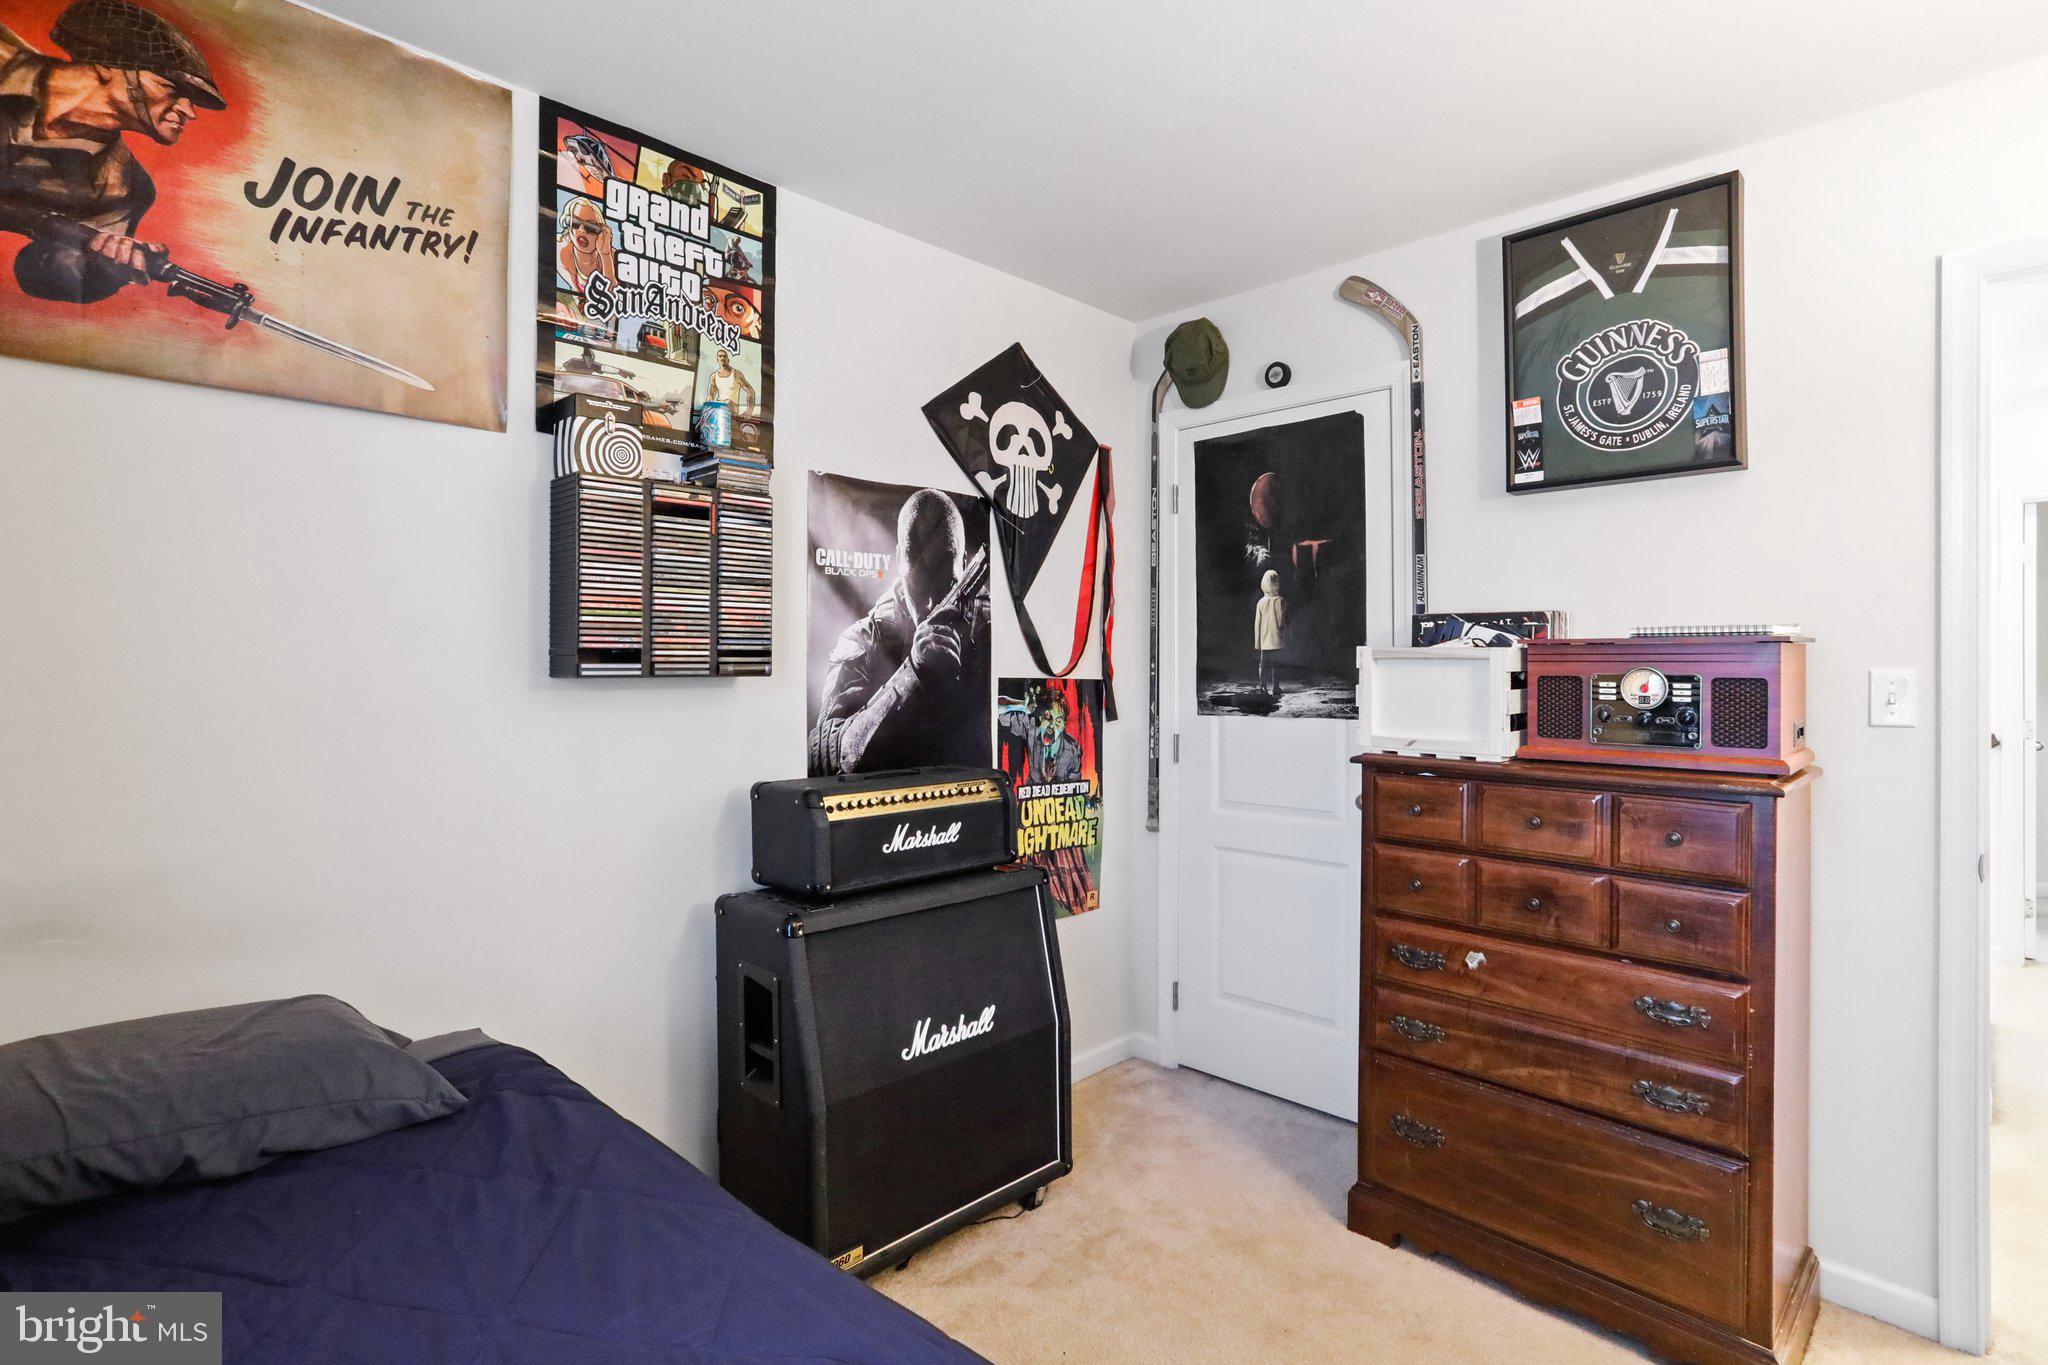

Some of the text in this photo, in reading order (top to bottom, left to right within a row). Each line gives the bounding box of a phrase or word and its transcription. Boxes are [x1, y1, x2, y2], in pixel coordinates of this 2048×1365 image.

[244, 157, 455, 228] JOIN THE
[269, 208, 479, 264] INFANTRY!
[1412, 324, 1420, 369] EASTON
[1561, 321, 1696, 381] GUINNESS
[1642, 390, 1662, 399] 1759
[1568, 413, 1598, 441] JAMES'S
[1599, 436, 1622, 446] GATE
[1632, 421, 1670, 444] DUBLIN,
[1665, 383, 1692, 421] IRELAND
[1695, 414, 1729, 429] SUPERSTAR
[815, 547, 891, 571] CALL DUTY
[824, 567, 857, 577] BLACK
[858, 569, 878, 578] OPS
[1416, 555, 1425, 602] ALUMINUM
[1018, 786, 1031, 799] RED
[1032, 784, 1051, 798] DEAD
[1021, 795, 1085, 827] UNDEAD
[882, 821, 962, 854] Marshall
[1016, 818, 1098, 857] IGHTMARE
[901, 1004, 996, 1061] Marshall
